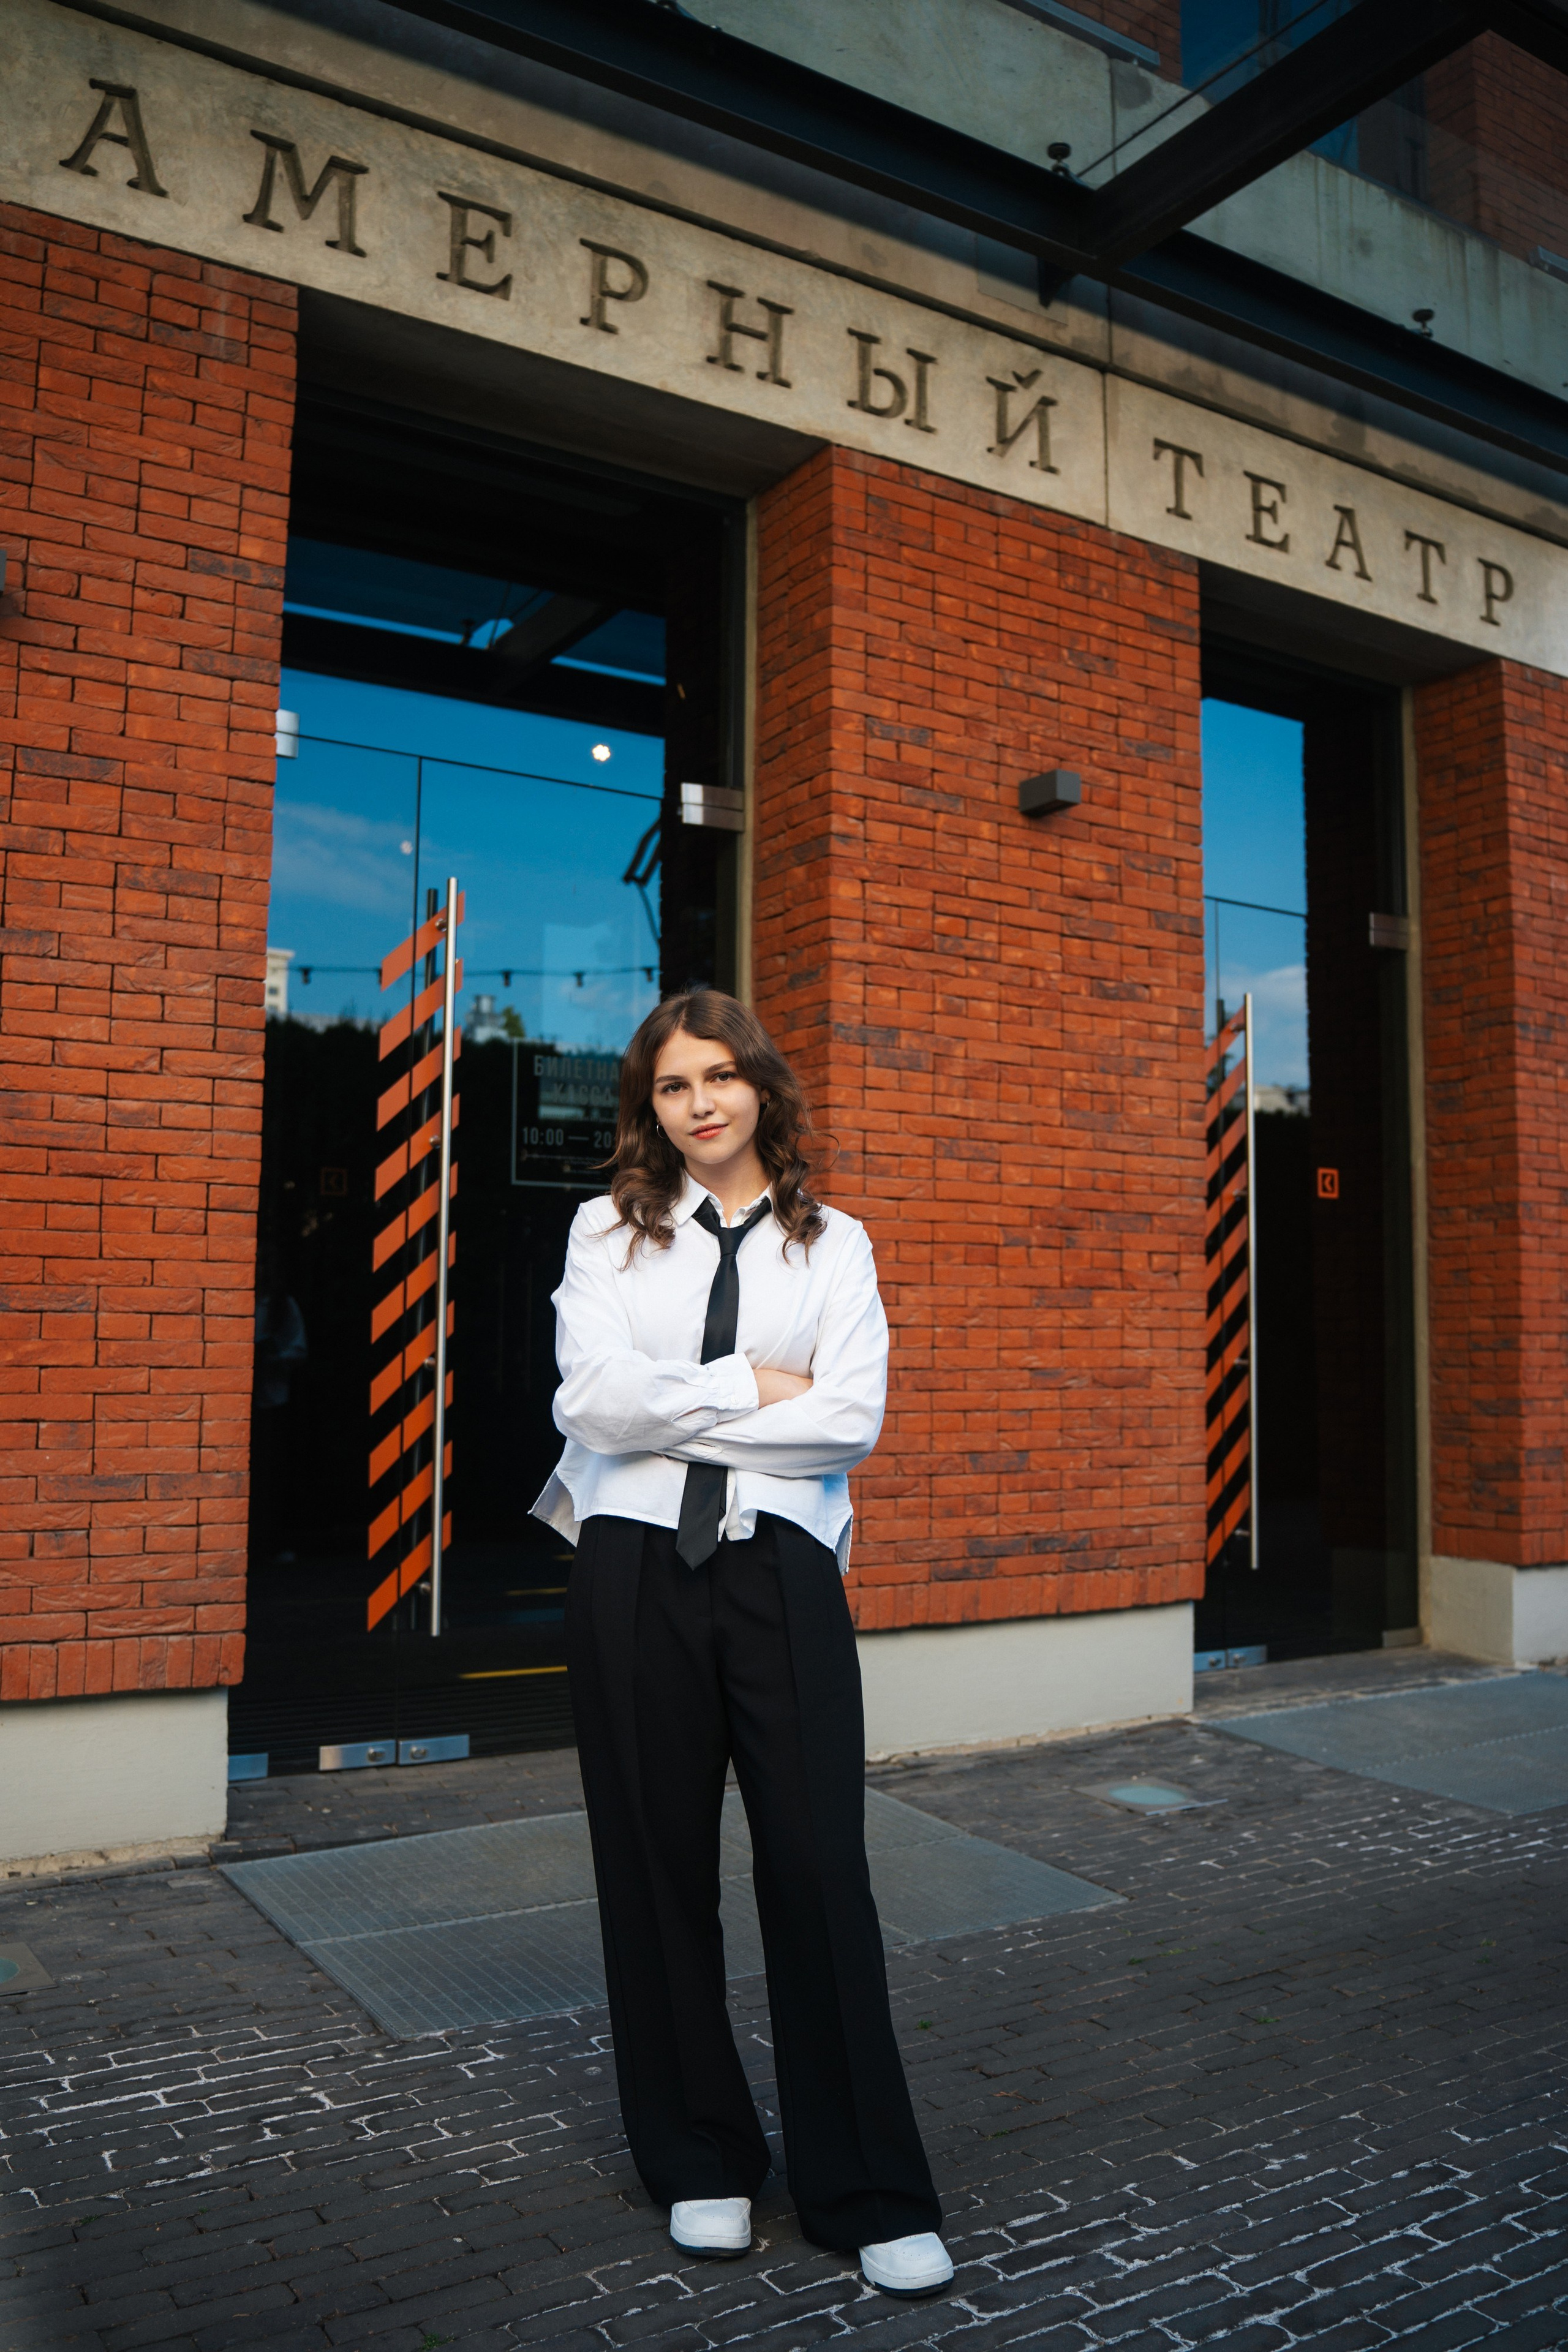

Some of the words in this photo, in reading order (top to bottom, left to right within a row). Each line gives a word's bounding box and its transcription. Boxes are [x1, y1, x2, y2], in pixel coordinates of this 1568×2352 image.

[59, 78, 1060, 475] АМЕРНЫЙ
[1153, 437, 1515, 627] ТЕАТР
[533, 1054, 620, 1082] БИЛЕТНА
[553, 1082, 614, 1107] КАССА
[522, 1126, 564, 1146] 10:00
